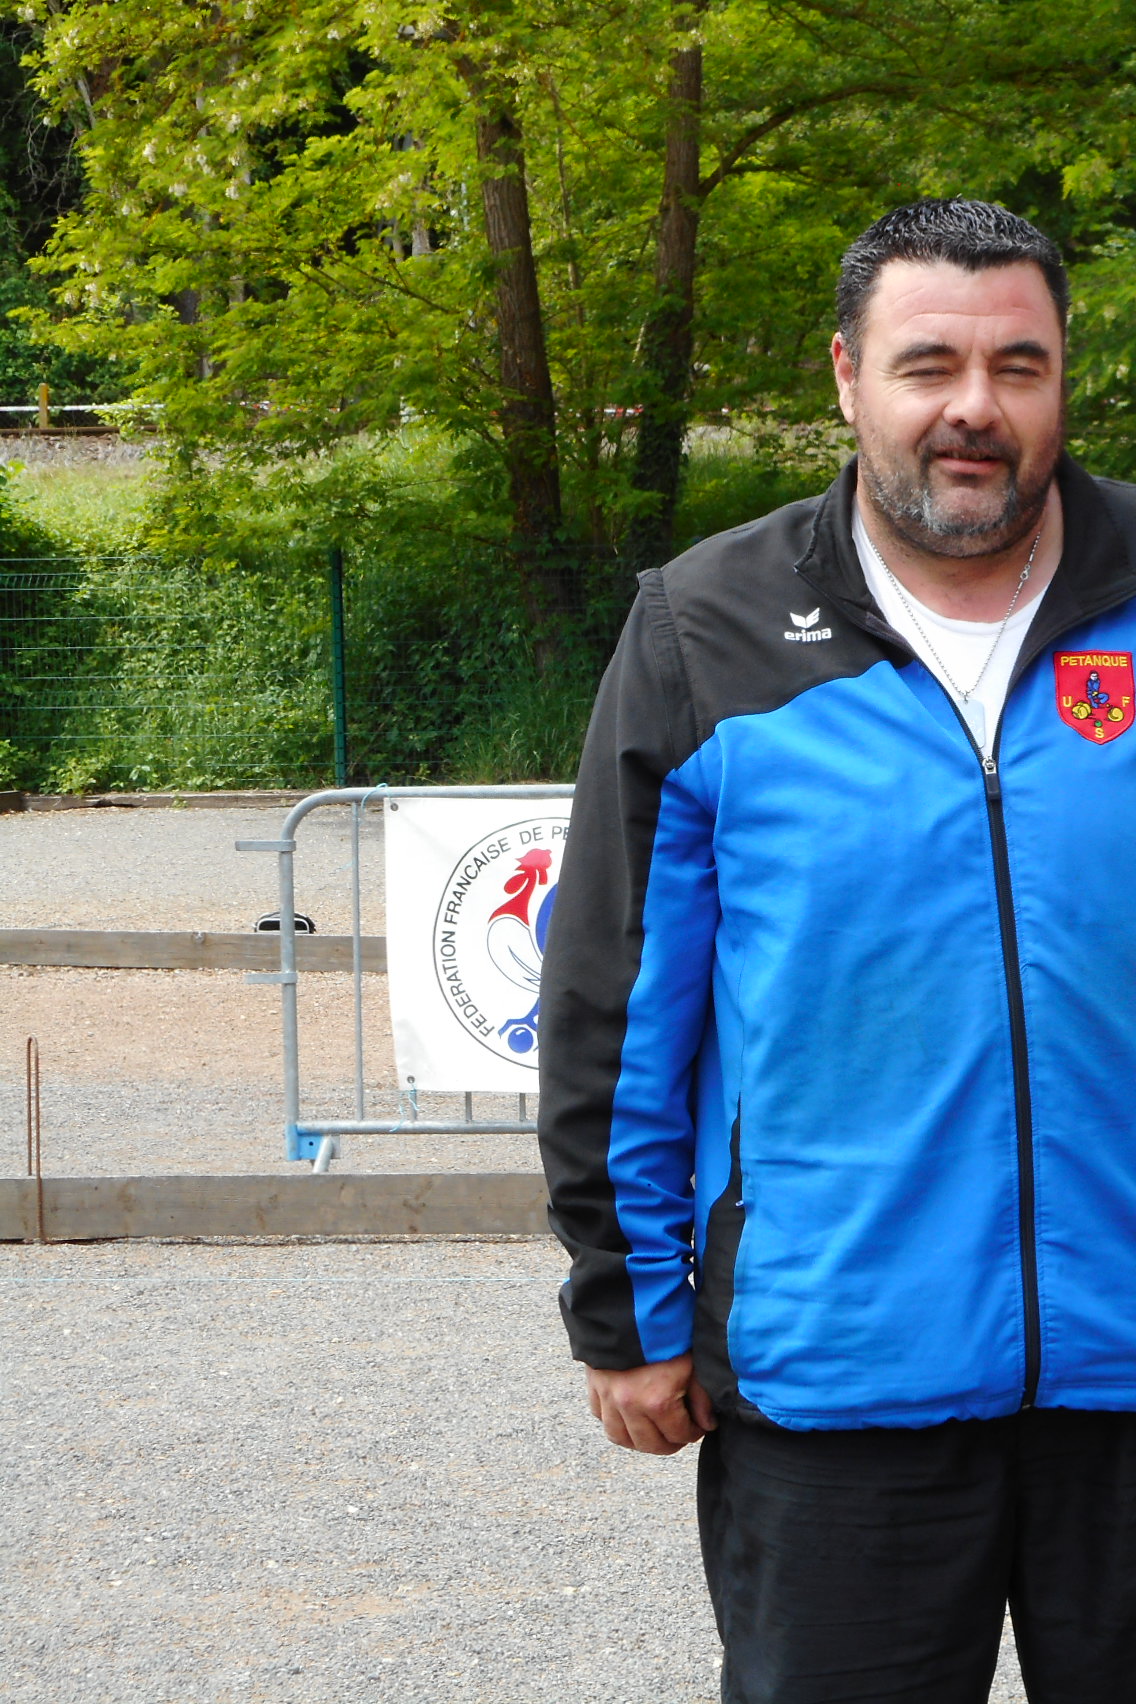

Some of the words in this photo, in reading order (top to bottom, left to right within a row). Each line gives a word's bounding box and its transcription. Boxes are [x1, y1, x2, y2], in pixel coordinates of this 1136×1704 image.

[784, 627, 832, 642] erima
[1060, 655, 1128, 667] PETANQUE
[1063, 696, 1073, 707] U
[1122, 696, 1130, 707] F
[1095, 728, 1105, 739] S
[440, 930, 495, 1037] FEDERATION
[519, 826, 544, 845] DE
